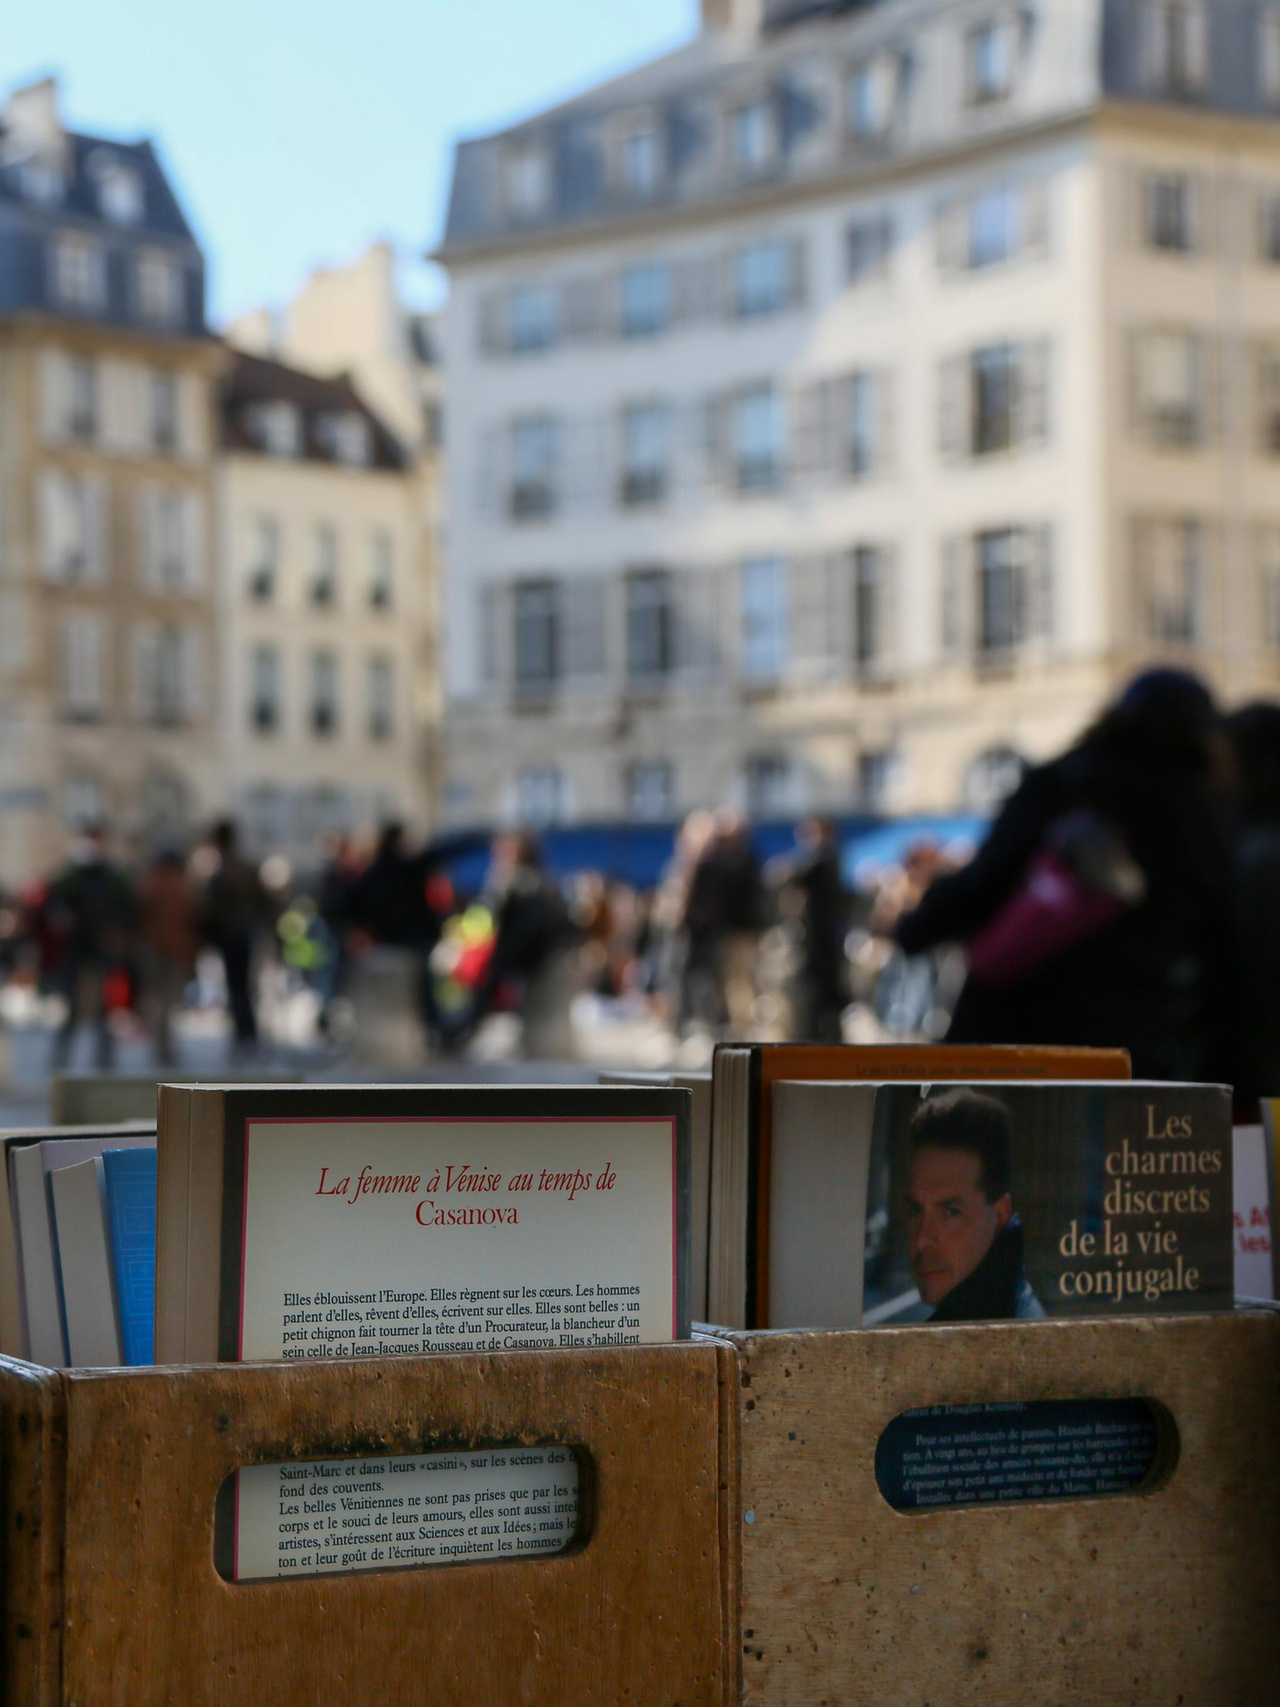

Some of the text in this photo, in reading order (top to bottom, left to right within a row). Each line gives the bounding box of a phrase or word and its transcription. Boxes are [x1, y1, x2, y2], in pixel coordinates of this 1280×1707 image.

[1146, 1104, 1192, 1139] Les
[1105, 1139, 1222, 1176] charmes
[315, 1162, 616, 1204] La femme à Venise au temps de
[1103, 1178, 1210, 1215] discrets
[415, 1200, 519, 1226] Casanova
[1059, 1220, 1178, 1257] de la vie
[1059, 1255, 1200, 1302] conjugale
[284, 1293, 311, 1306] Elles
[313, 1291, 376, 1305] éblouissent
[430, 1289, 457, 1302] Elles
[459, 1287, 500, 1303] règnent
[502, 1290, 520, 1300] sur
[521, 1287, 536, 1299] les
[575, 1285, 594, 1297] Les
[596, 1284, 640, 1297] hommes
[283, 1310, 322, 1326] parlent
[325, 1309, 362, 1324] d'elles,
[365, 1307, 400, 1321] rêvent
[402, 1307, 439, 1321] d'elles,
[441, 1305, 484, 1318] écrivent
[486, 1307, 503, 1317] sur
[505, 1303, 532, 1316] elles.
[535, 1302, 561, 1315] Elles
[563, 1303, 586, 1314] sont
[588, 1300, 618, 1313] belles
[626, 1303, 640, 1312] un
[282, 1316, 640, 1344] petit chignon fait tourner la tête d'un Procurateur, la blancheur d'un
[282, 1332, 640, 1358] sein celle de Jean-Jacques Rousseau et de Casanova. Elles s'habillent
[280, 1465, 341, 1480] Saint-Marc
[344, 1465, 355, 1476] et
[358, 1463, 385, 1475] dans
[388, 1461, 415, 1473] leurs
[470, 1458, 488, 1468] sur
[490, 1454, 506, 1467] les
[509, 1453, 543, 1466] scènes
[547, 1451, 566, 1463] des
[280, 1481, 384, 1498] fond des couvents.
[280, 1502, 299, 1515] Les
[303, 1500, 336, 1513] belles
[340, 1496, 403, 1511] Vénitiennes
[407, 1496, 420, 1506] ne
[424, 1493, 448, 1505] sont
[452, 1493, 470, 1506] pas
[474, 1488, 505, 1504] prises
[509, 1489, 528, 1502] que
[532, 1487, 550, 1500] par
[553, 1483, 568, 1496] les
[278, 1522, 309, 1535] corps
[312, 1519, 324, 1531] et
[327, 1517, 337, 1530] le
[341, 1514, 370, 1528] souci
[374, 1514, 388, 1526] de
[391, 1512, 418, 1525] leurs
[422, 1511, 466, 1523] amours,
[469, 1506, 494, 1519] elles
[497, 1505, 520, 1517] sont
[523, 1501, 550, 1515] aussi
[278, 1536, 321, 1550] artistes,
[324, 1530, 392, 1547] s'intéressent
[395, 1531, 415, 1541] aux
[418, 1526, 464, 1540] Sciences
[467, 1525, 478, 1536] et
[480, 1525, 500, 1535] aux
[538, 1517, 563, 1531] mais
[278, 1557, 296, 1568] ton
[300, 1555, 311, 1566] et
[315, 1553, 338, 1565] leur
[341, 1549, 366, 1566] goût
[370, 1548, 384, 1561] de
[388, 1545, 435, 1560] l'écriture
[439, 1540, 493, 1558] inquiètent
[497, 1539, 512, 1551] les
[516, 1537, 562, 1550] hommes
